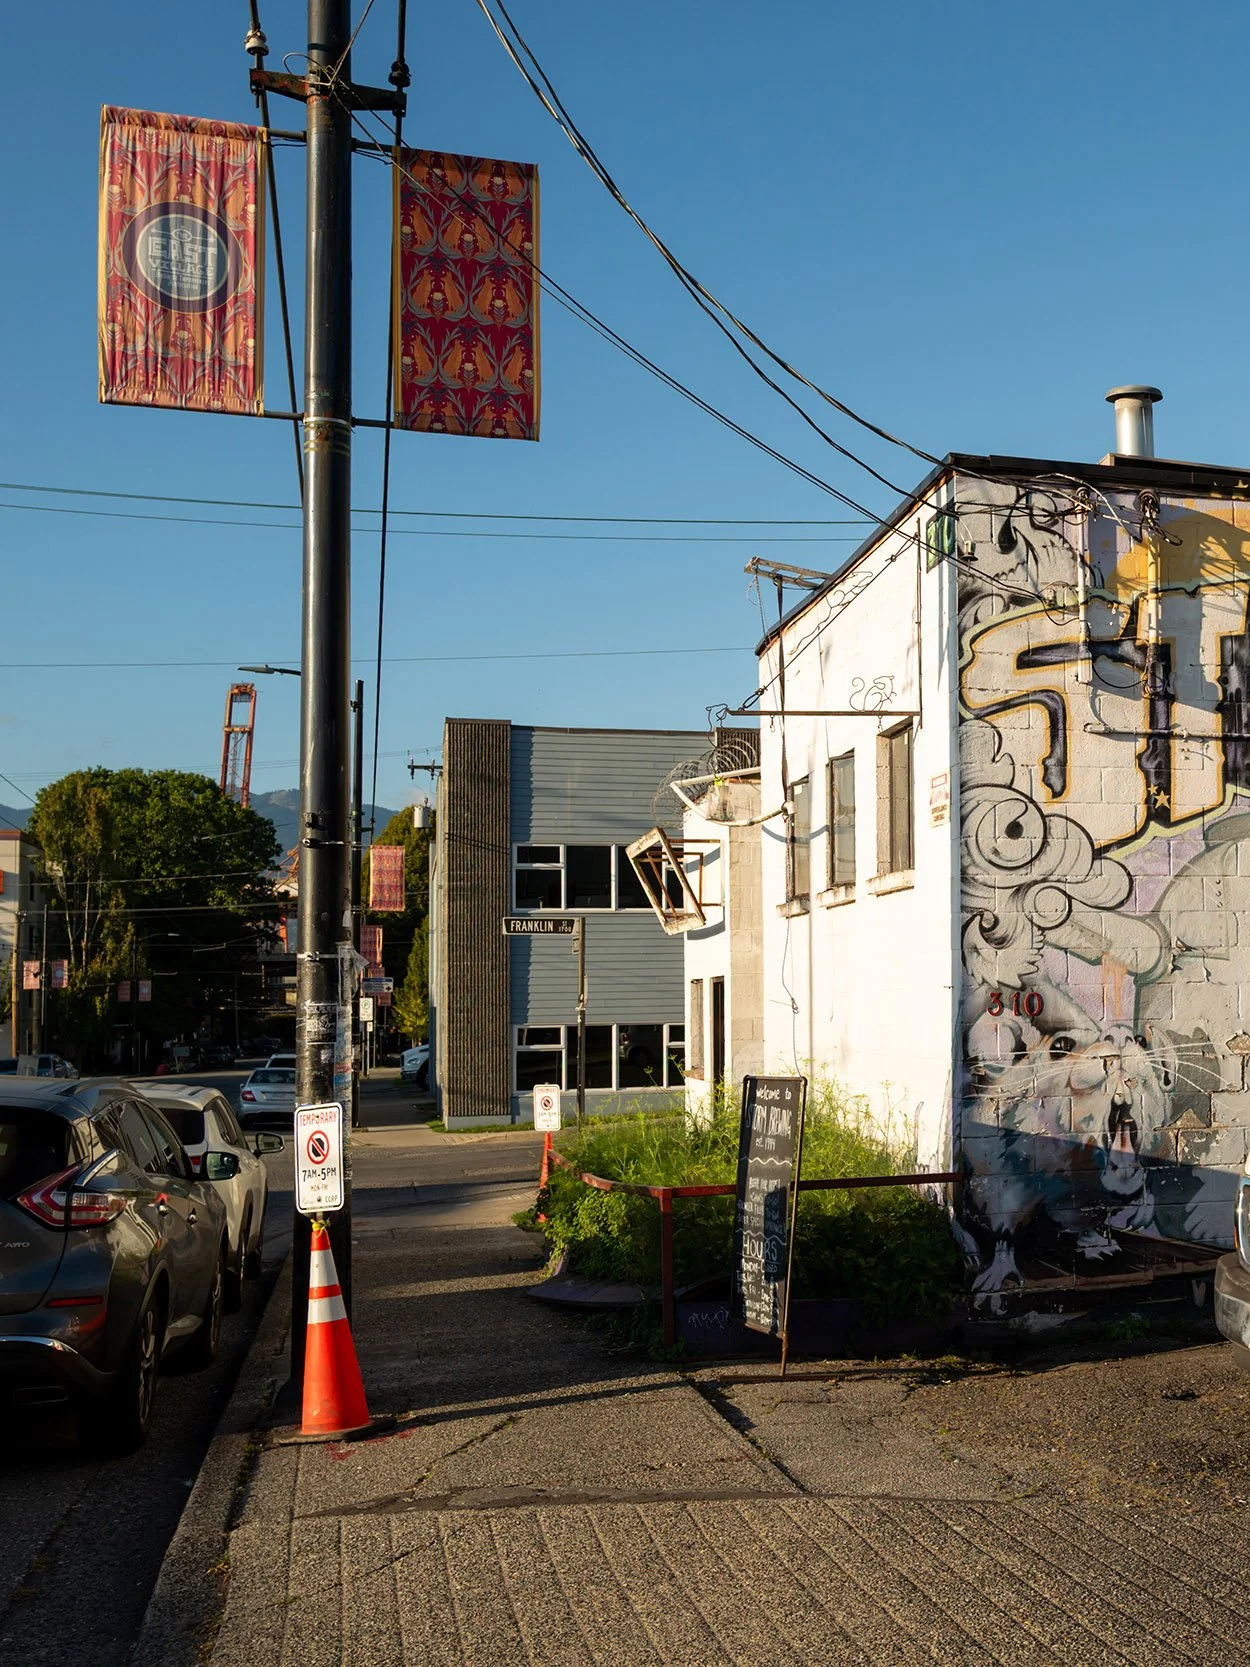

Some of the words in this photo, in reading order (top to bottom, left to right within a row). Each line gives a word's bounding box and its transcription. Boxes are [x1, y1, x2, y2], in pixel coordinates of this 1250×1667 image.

[148, 236, 217, 268] EAST
[148, 257, 214, 281] VILLAGE
[510, 920, 554, 932] FRANKLIN
[756, 1084, 780, 1100] welcome
[785, 1087, 792, 1100] to
[299, 1110, 337, 1127] TEMPORARY
[301, 1166, 337, 1182] 7AM-5PM
[742, 1235, 778, 1262] HOURS
